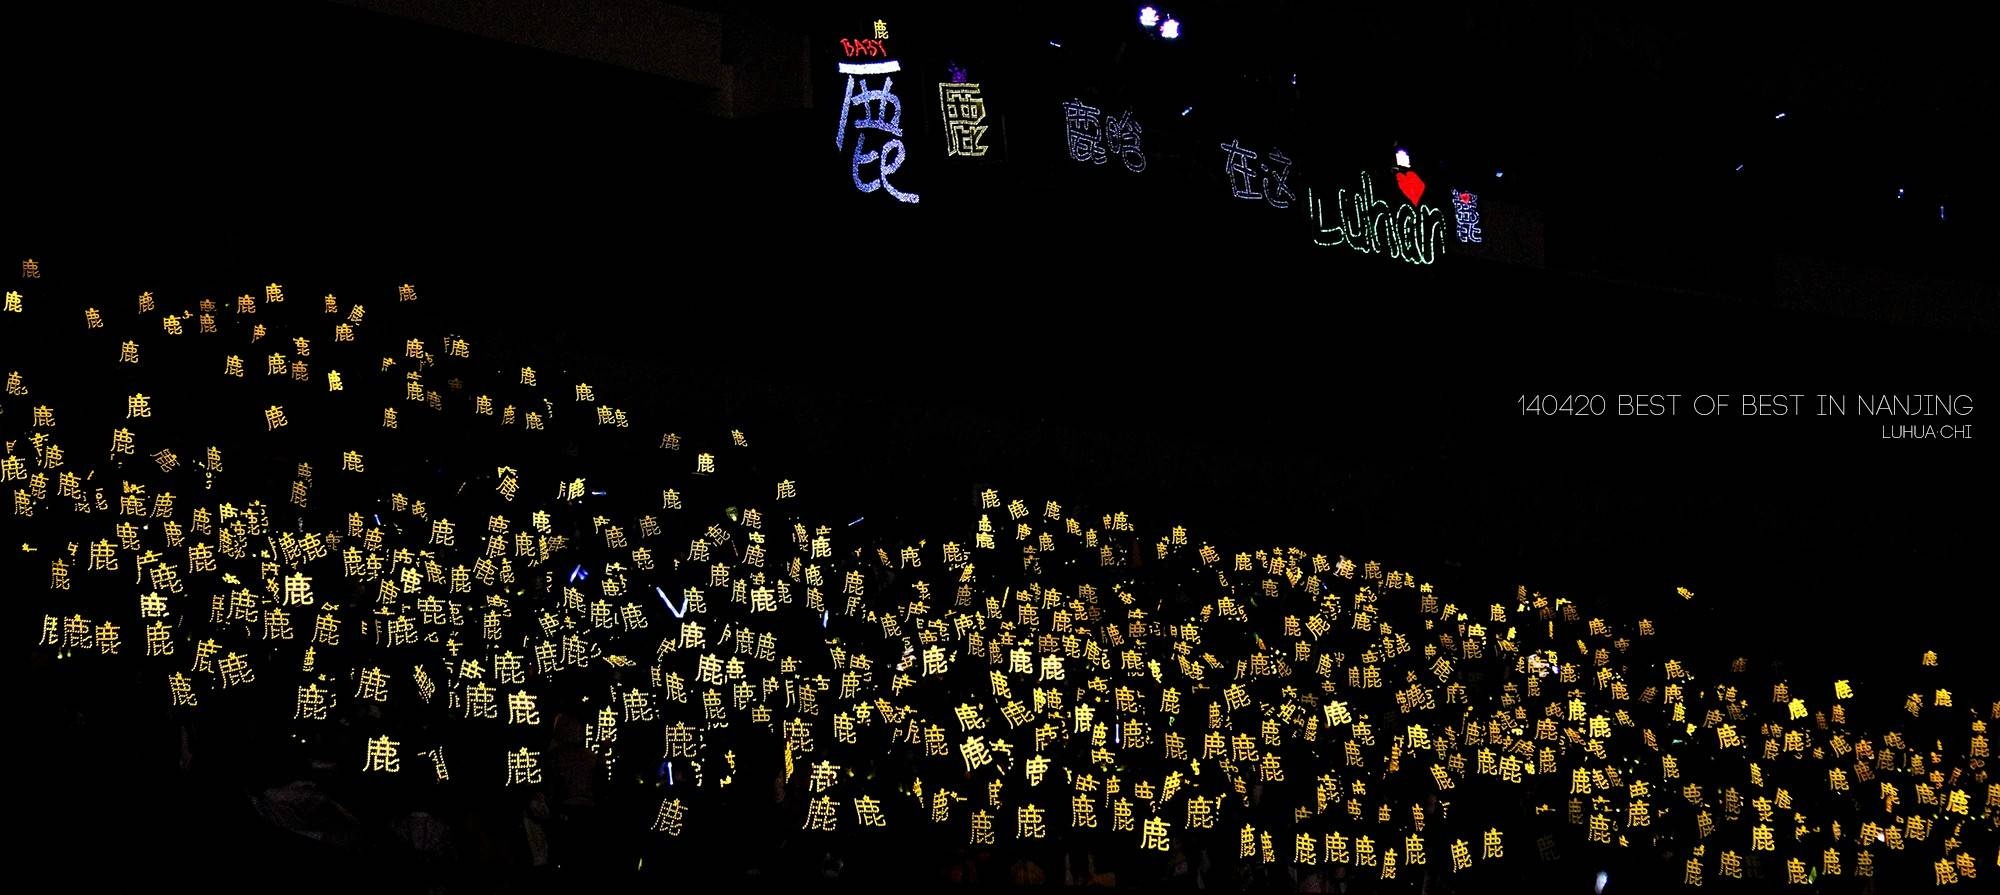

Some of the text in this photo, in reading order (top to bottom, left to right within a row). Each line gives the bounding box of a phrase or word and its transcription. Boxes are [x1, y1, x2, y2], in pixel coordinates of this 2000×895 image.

[873, 19, 889, 39] 鹿
[836, 60, 920, 204] 鹿
[938, 82, 989, 157] 鹿
[1062, 98, 1146, 173] 鹿晗
[1220, 139, 1296, 209] 在这
[1308, 170, 1446, 265] Luhan
[4, 291, 23, 312] 鹿
[139, 292, 154, 314] 鹿
[266, 283, 283, 303] 鹿
[399, 284, 417, 301] 鹿
[85, 308, 103, 328] 鹿
[164, 314, 183, 335] 鹿
[335, 323, 354, 342] 鹿
[119, 340, 139, 363] 鹿
[406, 338, 424, 359] 鹿
[450, 339, 469, 358] 鹿
[224, 355, 244, 377] 鹿
[268, 352, 287, 375] 鹿
[520, 367, 536, 386] 鹿
[328, 370, 343, 391] 鹿
[576, 383, 594, 401] 鹿
[33, 405, 55, 426] 鹿
[126, 393, 151, 419] 鹿
[265, 405, 288, 431] 鹿
[476, 395, 493, 415] 鹿
[502, 405, 516, 424] 鹿
[526, 412, 544, 430] 鹿
[111, 427, 135, 455] 鹿
[1, 455, 27, 482] 鹿
[44, 444, 64, 468] 鹿
[342, 450, 364, 472] 鹿
[696, 453, 714, 474] 鹿
[57, 472, 82, 500] 鹿
[567, 478, 586, 501] 鹿
[663, 488, 681, 509] 鹿
[776, 479, 796, 500] 鹿
[981, 489, 1000, 509] 鹿
[150, 492, 176, 518] 鹿
[741, 508, 762, 529] 鹿
[1008, 500, 1029, 520] 鹿
[1043, 501, 1061, 520] 鹿
[429, 518, 455, 546] 鹿
[533, 510, 551, 534] 鹿
[1112, 511, 1128, 531] 鹿
[117, 522, 140, 550] 鹿
[298, 532, 327, 564] 鹿
[515, 531, 535, 556] 鹿
[811, 536, 831, 559] 鹿
[1172, 525, 1187, 548] 鹿
[88, 538, 118, 570] 鹿
[189, 542, 216, 573] 鹿
[687, 538, 711, 562] 鹿
[1235, 552, 1252, 571] 鹿
[1312, 554, 1330, 573] 鹿
[150, 562, 183, 593] 鹿
[710, 562, 730, 587] 鹿
[843, 570, 864, 595] 鹿
[1386, 571, 1403, 589] 鹿
[282, 572, 313, 606] 鹿
[684, 586, 706, 613] 鹿
[750, 586, 777, 613] 鹿
[227, 588, 258, 622] 鹿
[591, 599, 613, 629] 鹿
[620, 602, 648, 632] 鹿
[1017, 603, 1039, 625] 鹿
[1218, 596, 1237, 616] 鹿
[1491, 603, 1506, 622] 鹿
[62, 614, 92, 648] 鹿
[263, 607, 293, 640] 鹿
[311, 613, 341, 645] 鹿
[387, 615, 418, 647] 鹿
[1052, 609, 1072, 633] 鹿
[96, 621, 121, 654] 鹿
[147, 620, 174, 656] 鹿
[678, 621, 706, 649] 鹿
[754, 632, 777, 661] 鹿
[218, 652, 255, 688] 鹿
[495, 650, 525, 684] 鹿
[695, 653, 724, 685] 鹿
[922, 645, 948, 677] 鹿
[1009, 647, 1033, 674] 鹿
[1039, 654, 1065, 681] 鹿
[1665, 659, 1683, 680] 鹿
[1923, 650, 1938, 666] 鹿
[169, 672, 197, 706] 鹿
[355, 667, 390, 702] 鹿
[666, 672, 687, 703] 鹿
[1363, 665, 1382, 688] 鹿
[1834, 680, 1853, 699] 鹿
[294, 683, 328, 720] 鹿
[465, 681, 497, 718] 鹿
[508, 690, 540, 725] 鹿
[623, 688, 653, 722] 鹿
[703, 688, 726, 719] 鹿
[1115, 686, 1137, 712] 鹿
[1160, 687, 1181, 714] 鹿
[1224, 684, 1251, 713] 鹿
[1568, 698, 1586, 721] 鹿
[1788, 698, 1808, 720] 鹿
[1934, 689, 1952, 707] 鹿
[954, 703, 985, 732] 鹿
[1001, 700, 1034, 729] 鹿
[1074, 703, 1095, 733] 鹿
[1324, 700, 1352, 728] 鹿
[1589, 714, 1611, 738] 鹿
[663, 721, 696, 758] 鹿
[834, 712, 856, 744] 鹿
[924, 724, 948, 756] 鹿
[1122, 718, 1145, 749] 鹿
[1407, 724, 1431, 750] 鹿
[1717, 724, 1740, 749] 鹿
[1783, 730, 1804, 752] 鹿
[363, 734, 400, 772] 鹿
[960, 736, 992, 772] 鹿
[1232, 733, 1259, 762] 鹿
[1477, 747, 1497, 775] 鹿
[506, 747, 542, 786] 鹿
[1499, 755, 1523, 783] 鹿
[1570, 767, 1591, 794] 鹿
[1829, 768, 1849, 795] 鹿
[802, 795, 840, 831] 鹿
[854, 795, 886, 826] 鹿
[1072, 793, 1097, 827] 鹿
[1112, 797, 1134, 831] 鹿
[1185, 795, 1213, 829] 鹿
[1626, 799, 1650, 827] 鹿
[1946, 789, 1971, 815] 鹿
[1016, 803, 1045, 838] 鹿
[1140, 816, 1170, 851] 鹿
[1588, 813, 1611, 843] 鹿
[1905, 815, 1926, 841] 鹿
[1294, 832, 1317, 865] 鹿
[1324, 831, 1349, 863] 鹿
[1355, 835, 1377, 866] 鹿
[1405, 833, 1426, 865] 鹿
[1483, 827, 1503, 859] 鹿
[1752, 824, 1775, 851] 鹿
[1451, 839, 1472, 873] 鹿
[1719, 850, 1742, 878] 鹿
[1787, 857, 1808, 884] 鹿
[1935, 858, 1958, 885] 鹿
